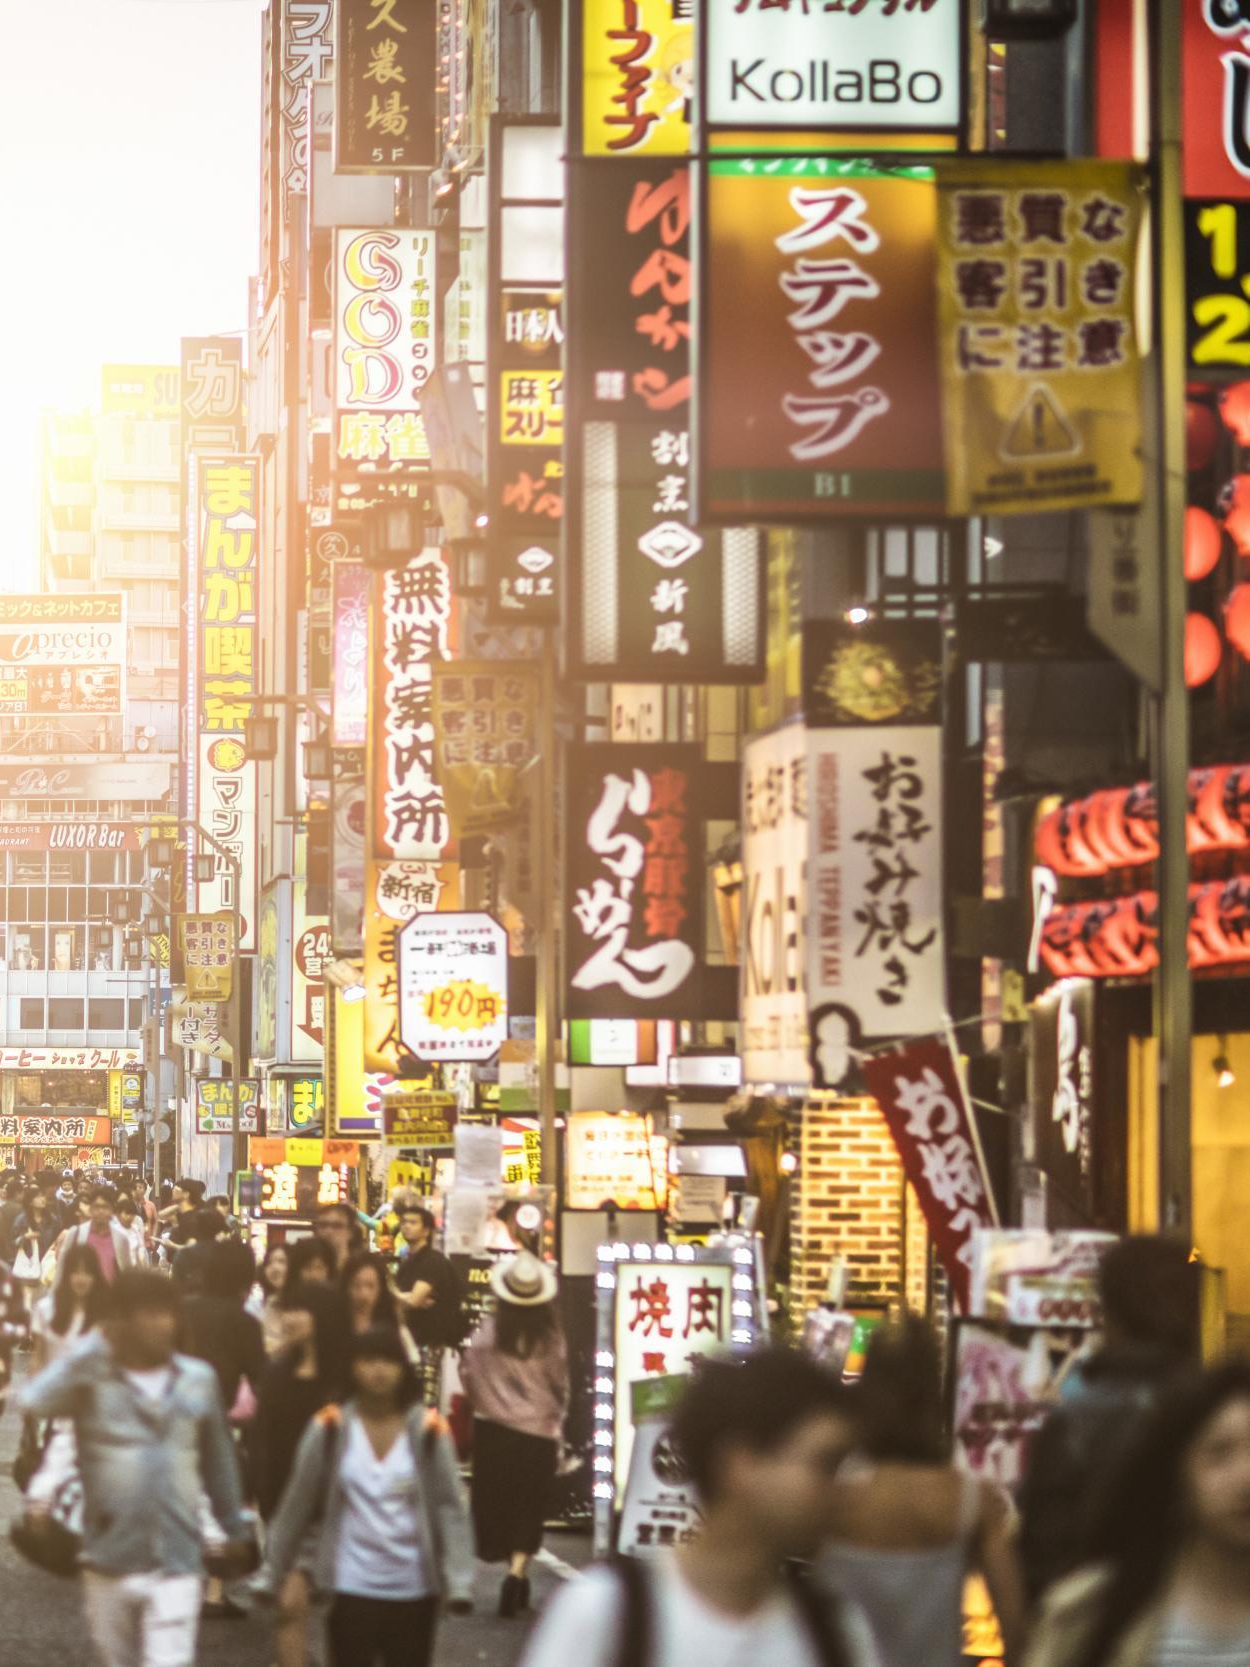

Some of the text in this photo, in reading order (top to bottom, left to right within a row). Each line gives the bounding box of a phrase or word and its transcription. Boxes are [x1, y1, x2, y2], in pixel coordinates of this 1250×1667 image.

[730, 58, 943, 104] KollaBo
[952, 190, 1126, 247] 悪質な
[952, 257, 1126, 312] 客引き
[342, 230, 403, 405] GOD
[774, 186, 891, 461] ステップ
[953, 322, 1127, 371] に注意
[204, 465, 254, 732] まんが喫茶
[386, 561, 450, 846] 無料案内所
[50, 823, 126, 849] LUXOR Bar
[381, 873, 436, 905] 新宿
[851, 749, 938, 1007] お好み焼き
[426, 986, 496, 1019] 190円
[51, 1051, 87, 1065] ショップ
[89, 1049, 121, 1069] クール
[627, 1275, 724, 1340] 焼肉
